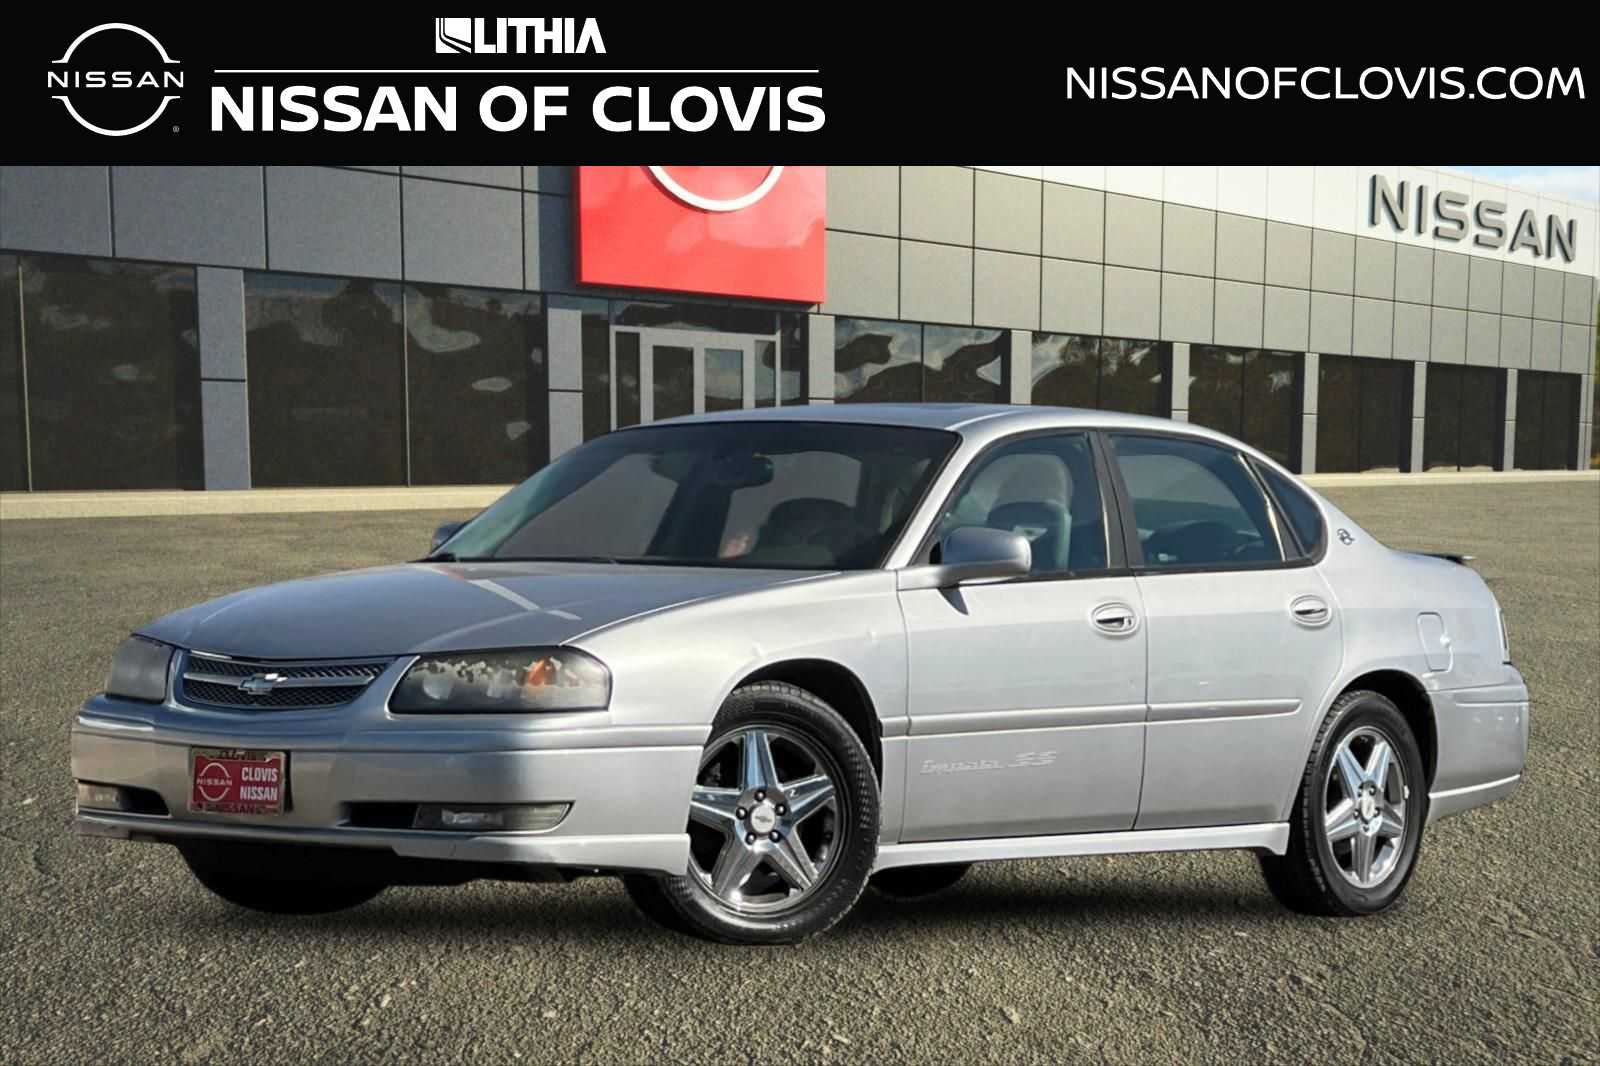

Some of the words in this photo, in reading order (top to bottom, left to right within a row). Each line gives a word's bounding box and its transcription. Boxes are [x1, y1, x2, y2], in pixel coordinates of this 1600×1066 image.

[1368, 173, 1577, 263] NISSAN
[197, 777, 233, 787] NISSAN
[241, 767, 279, 783] CLOVIS
[240, 786, 278, 801] NISSAN
